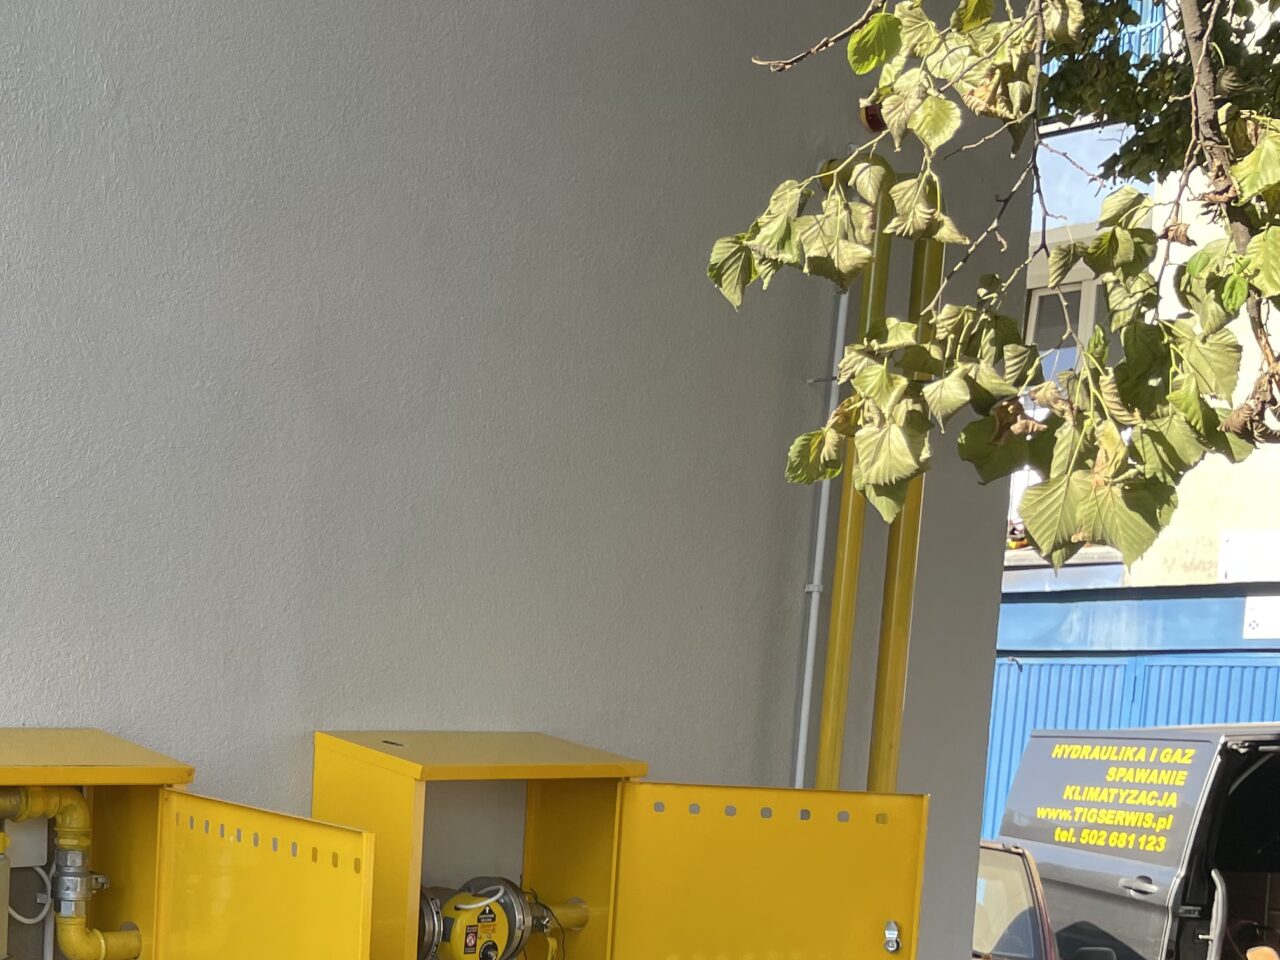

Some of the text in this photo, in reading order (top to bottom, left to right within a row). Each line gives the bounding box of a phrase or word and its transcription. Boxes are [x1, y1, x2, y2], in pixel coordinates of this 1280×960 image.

[1052, 744, 1196, 764] HYDRAULIKA I GAZ
[1106, 767, 1188, 786] SPAWANIE
[1063, 785, 1178, 808] KLIMATYZACJA
[1036, 807, 1173, 832] www.TIGSERWIS.pl
[1054, 827, 1166, 852] tel. 502 681 123
